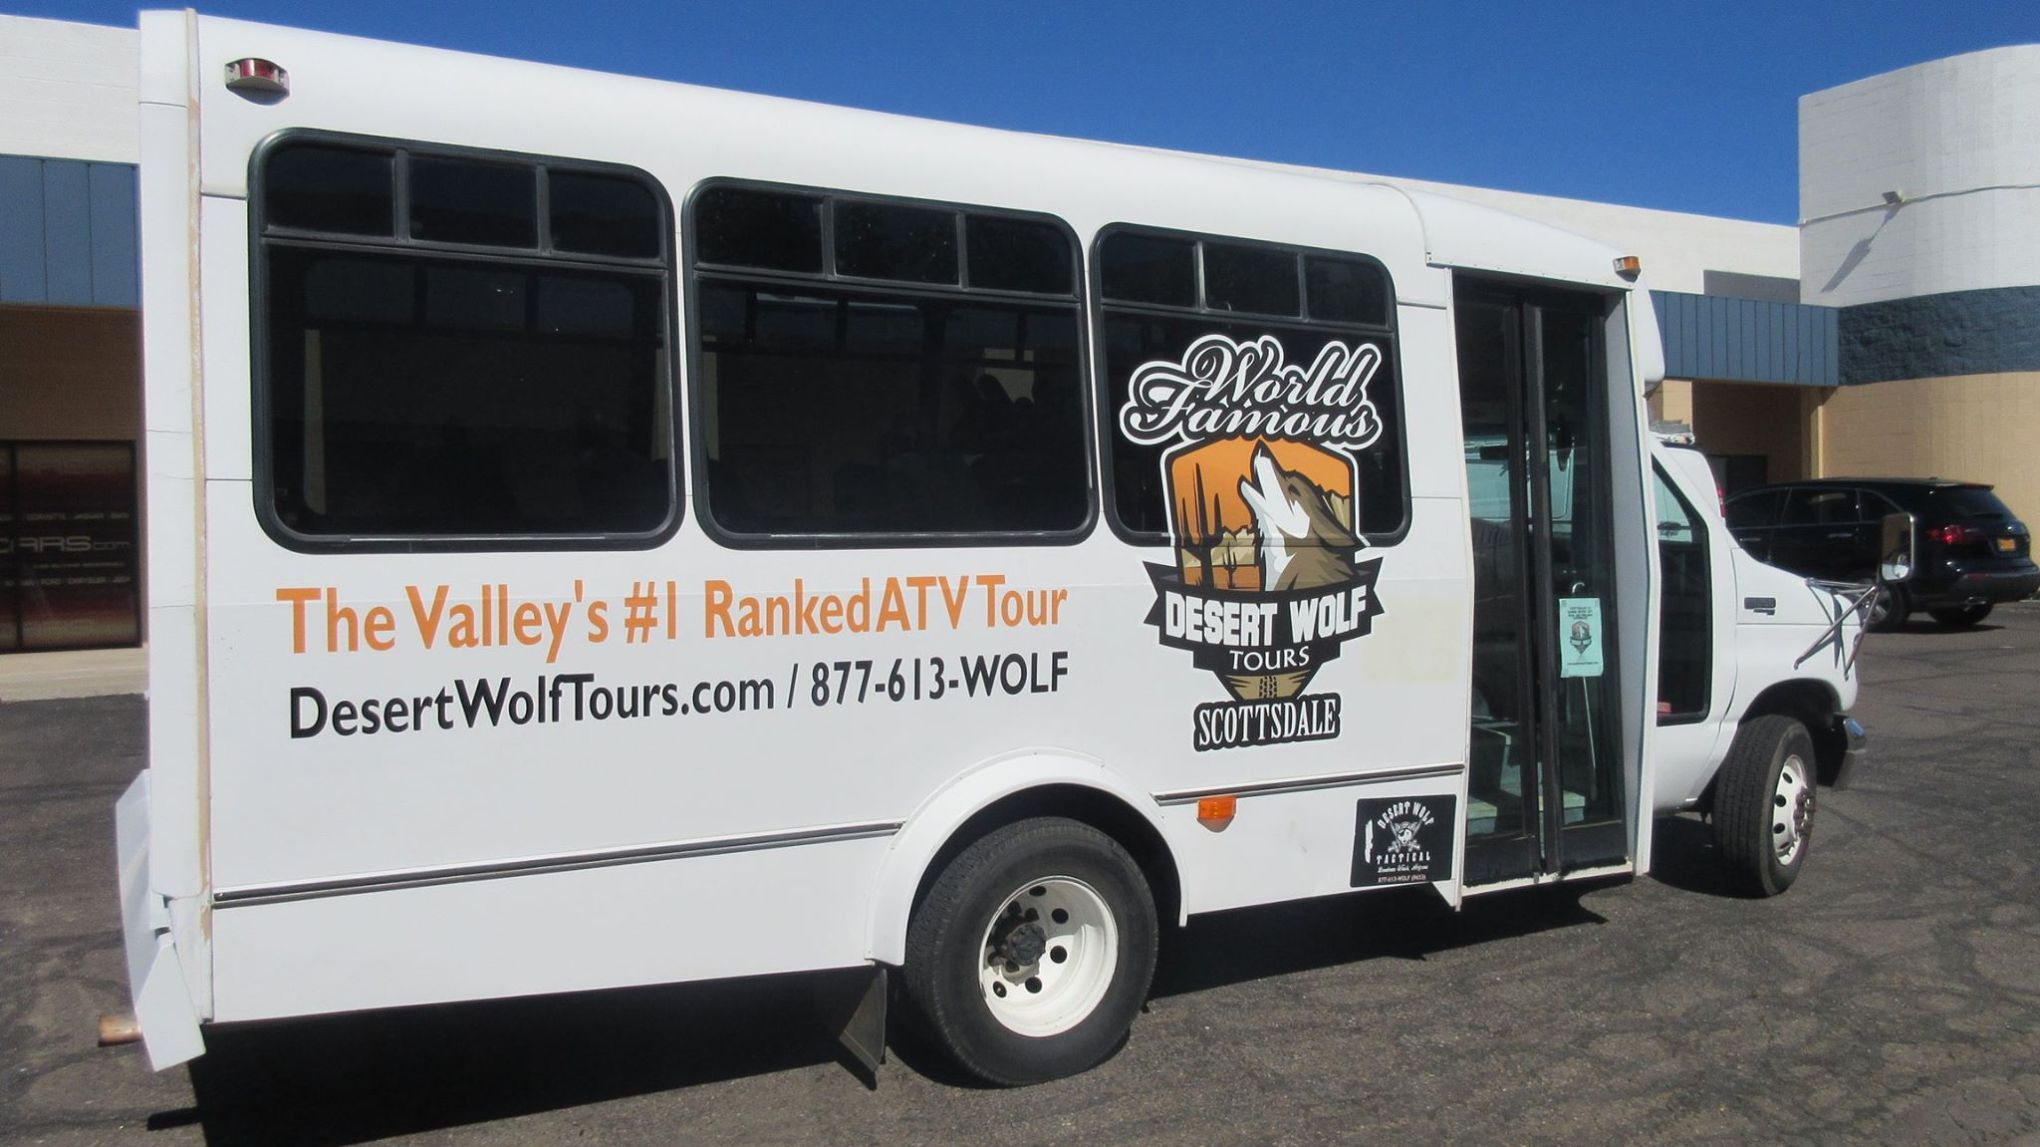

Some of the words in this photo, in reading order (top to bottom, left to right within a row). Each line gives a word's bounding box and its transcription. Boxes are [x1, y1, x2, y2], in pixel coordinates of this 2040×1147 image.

[1129, 371, 1375, 439] Famous
[1190, 344, 1374, 407] World
[276, 587, 396, 654] The
[405, 579, 609, 663] Valley's
[975, 574, 1068, 628] Tour
[1165, 590, 1278, 647] DESERT
[1289, 584, 1367, 644] WOLF
[1229, 645, 1310, 671] TOURS
[290, 673, 775, 739] DesertWolfTours.com
[811, 651, 1069, 707] 877-613-WOLF
[1198, 698, 1337, 746] SCOTTSDALE
[1377, 801, 1411, 829] DESERT
[1412, 801, 1435, 826] WOLF
[1376, 851, 1431, 865] TACTICAL
